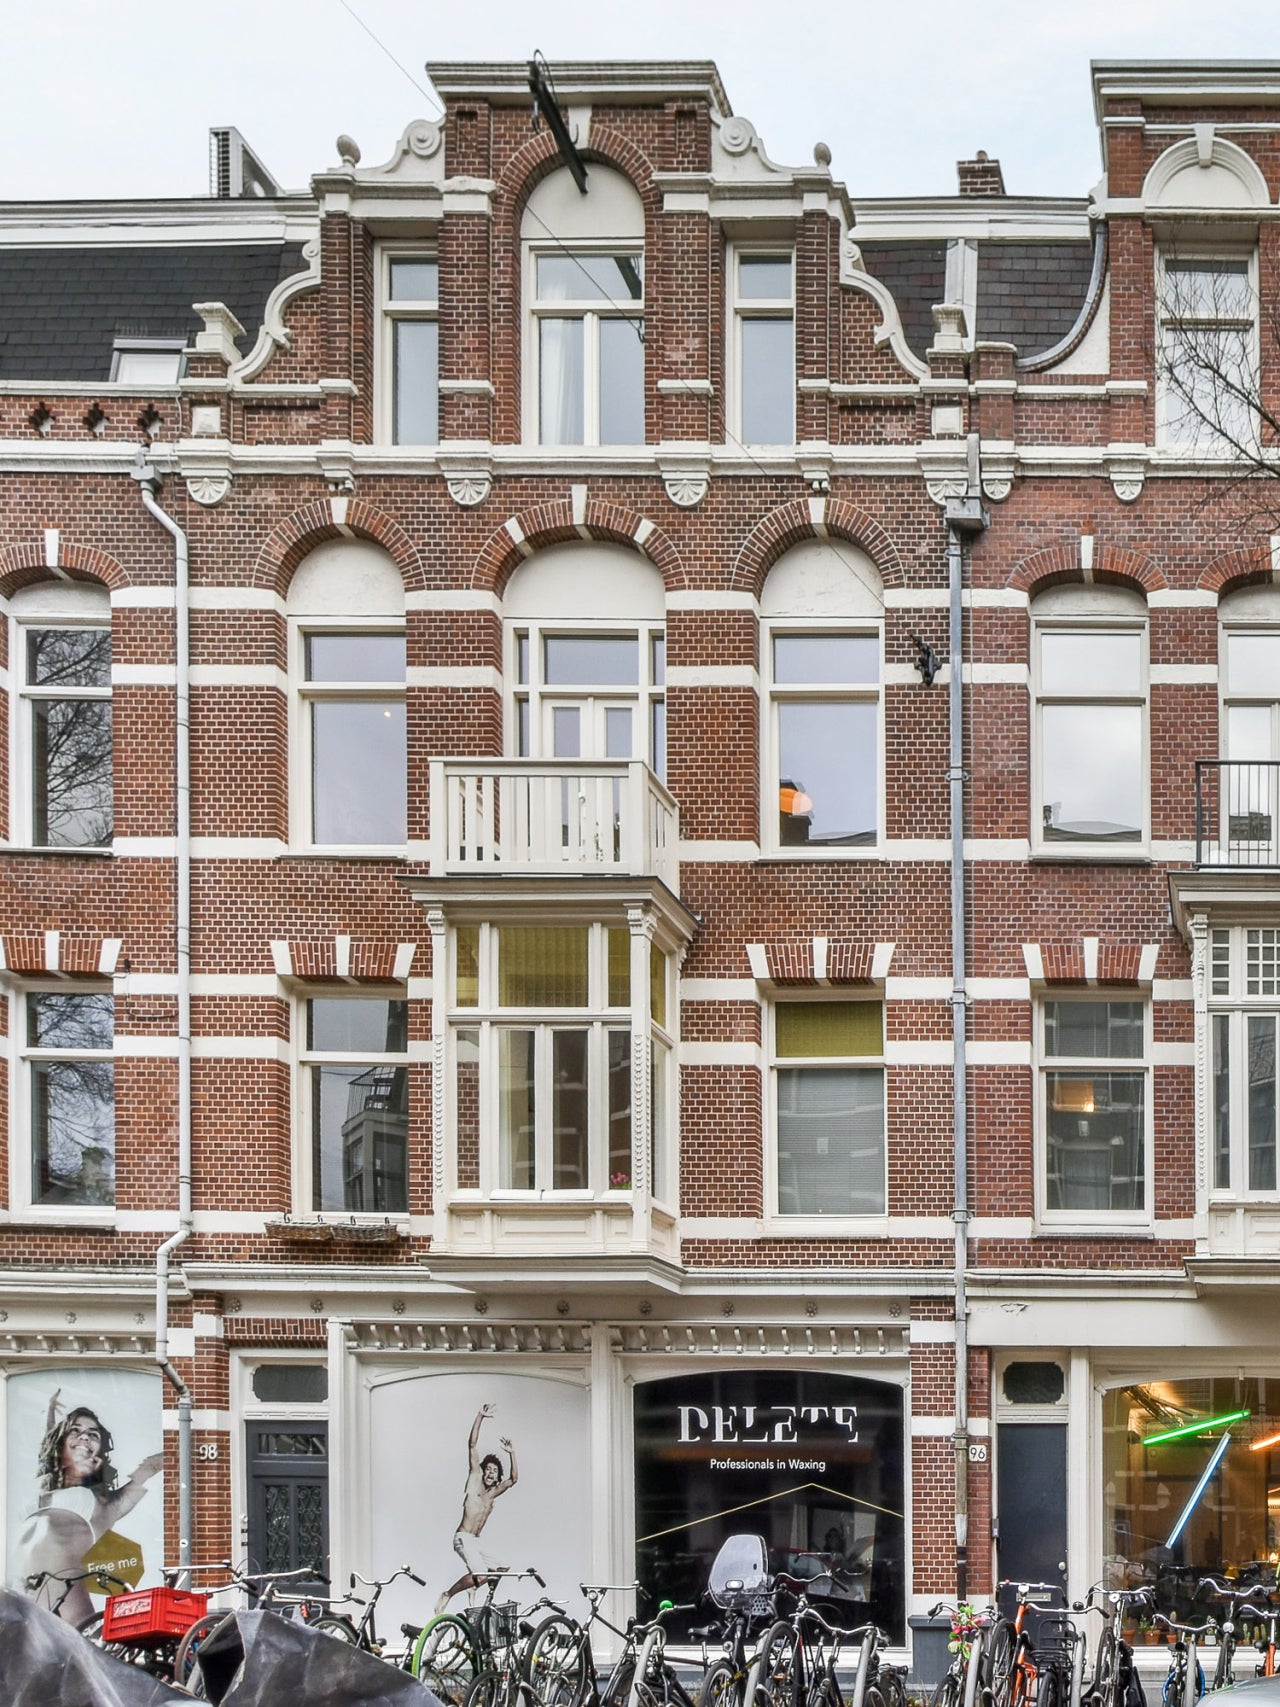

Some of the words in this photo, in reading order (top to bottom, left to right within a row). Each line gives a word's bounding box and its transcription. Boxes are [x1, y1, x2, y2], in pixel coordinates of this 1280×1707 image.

[677, 1406, 859, 1443] DELETE
[199, 1443, 218, 1460] 98
[970, 1447, 986, 1460] 96
[710, 1458, 774, 1470] Professionals
[776, 1459, 786, 1470] in
[788, 1459, 827, 1472] Waxing
[87, 1562, 115, 1574] Free
[119, 1557, 138, 1569] me
